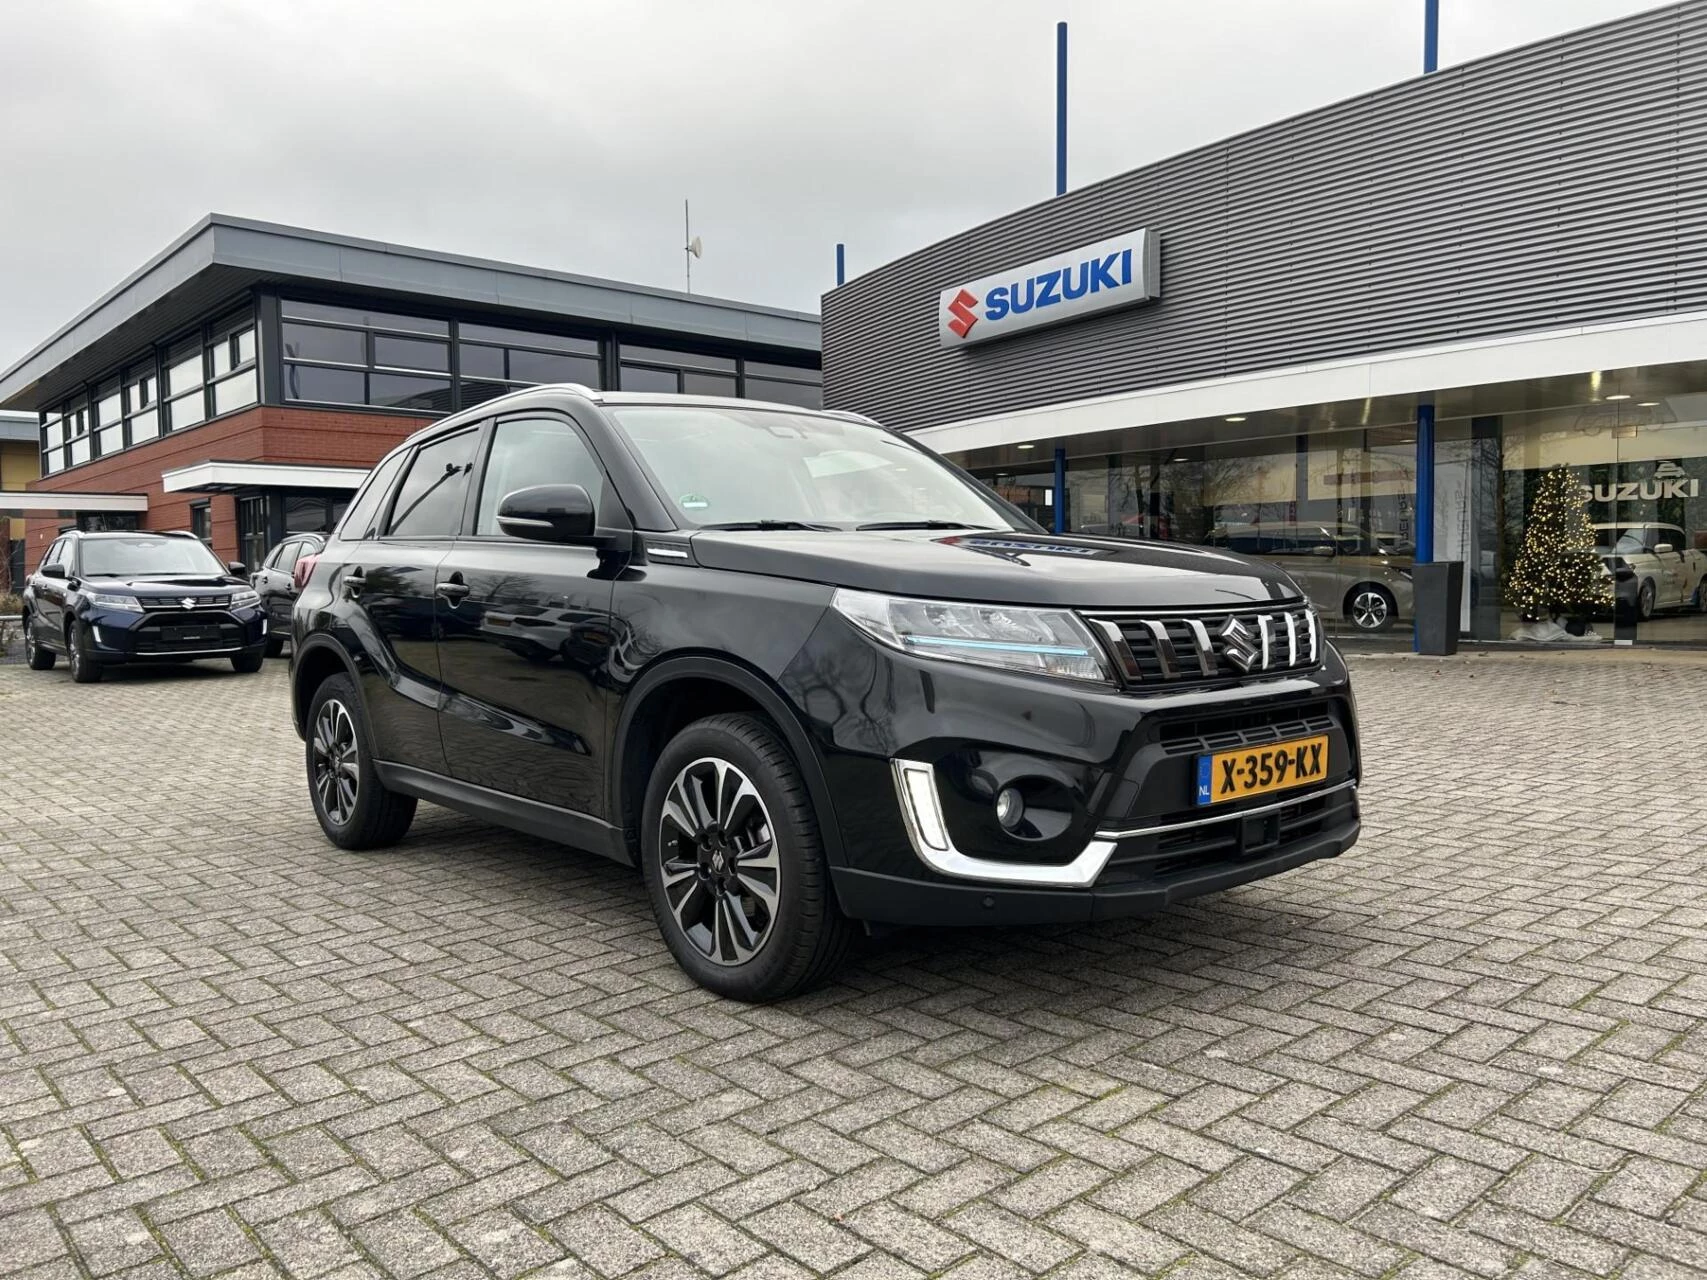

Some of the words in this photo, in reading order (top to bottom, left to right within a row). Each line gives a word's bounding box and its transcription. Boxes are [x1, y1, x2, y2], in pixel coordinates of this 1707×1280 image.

[985, 248, 1132, 321] SUZUKI
[1199, 785, 1209, 796] NL
[1220, 743, 1322, 794] X-359-KX
